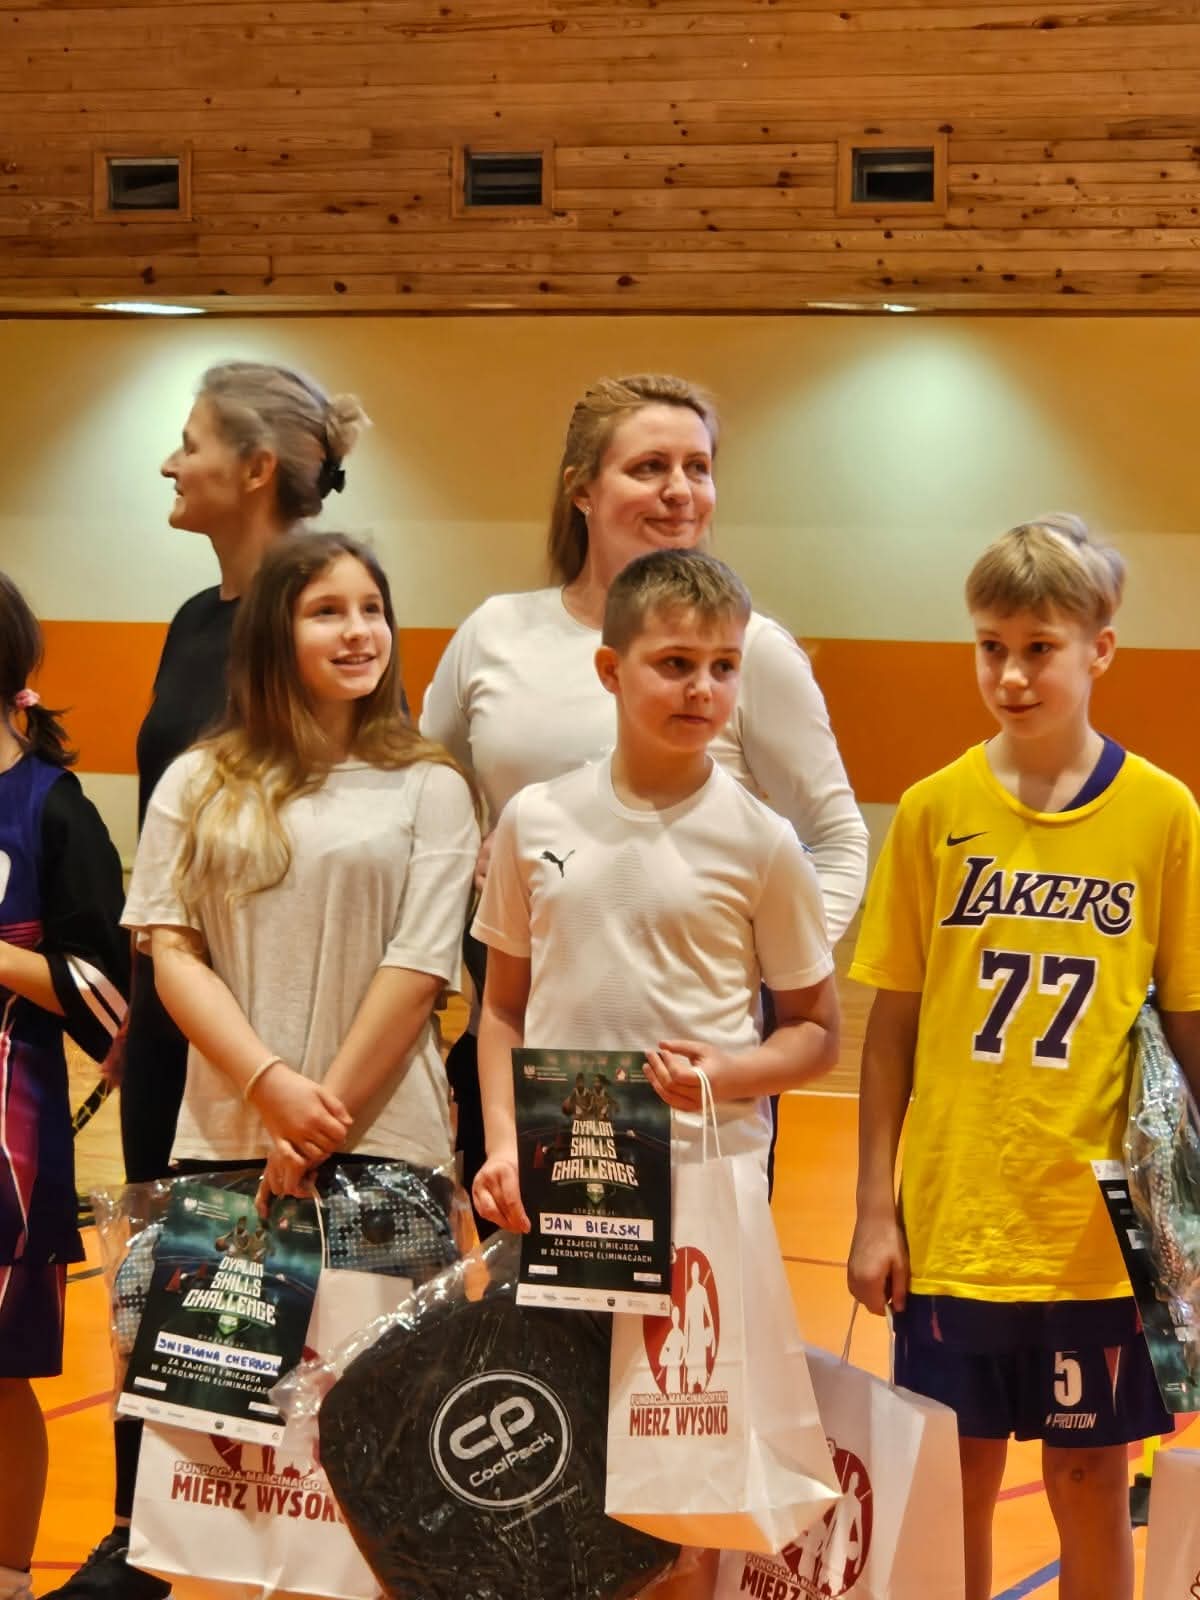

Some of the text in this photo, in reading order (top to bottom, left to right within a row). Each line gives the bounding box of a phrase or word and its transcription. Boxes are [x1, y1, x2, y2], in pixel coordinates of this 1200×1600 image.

[940, 856, 1137, 937] LAKERS
[971, 949, 1100, 1069] 77
[551, 1158, 639, 1187] CHALLENGE
[544, 1217, 640, 1238] JAN BIELSKI
[550, 1248, 594, 1259] SZKOLNYCH
[597, 1251, 652, 1263] ELIMINACJACH
[182, 1288, 277, 1326] CHALLENGE
[161, 1365, 211, 1383] SZKOLNYCH
[1053, 1351, 1082, 1407] 5
[629, 1405, 728, 1437] MIERZ WYSOKO
[171, 1473, 249, 1511] MIERZ
